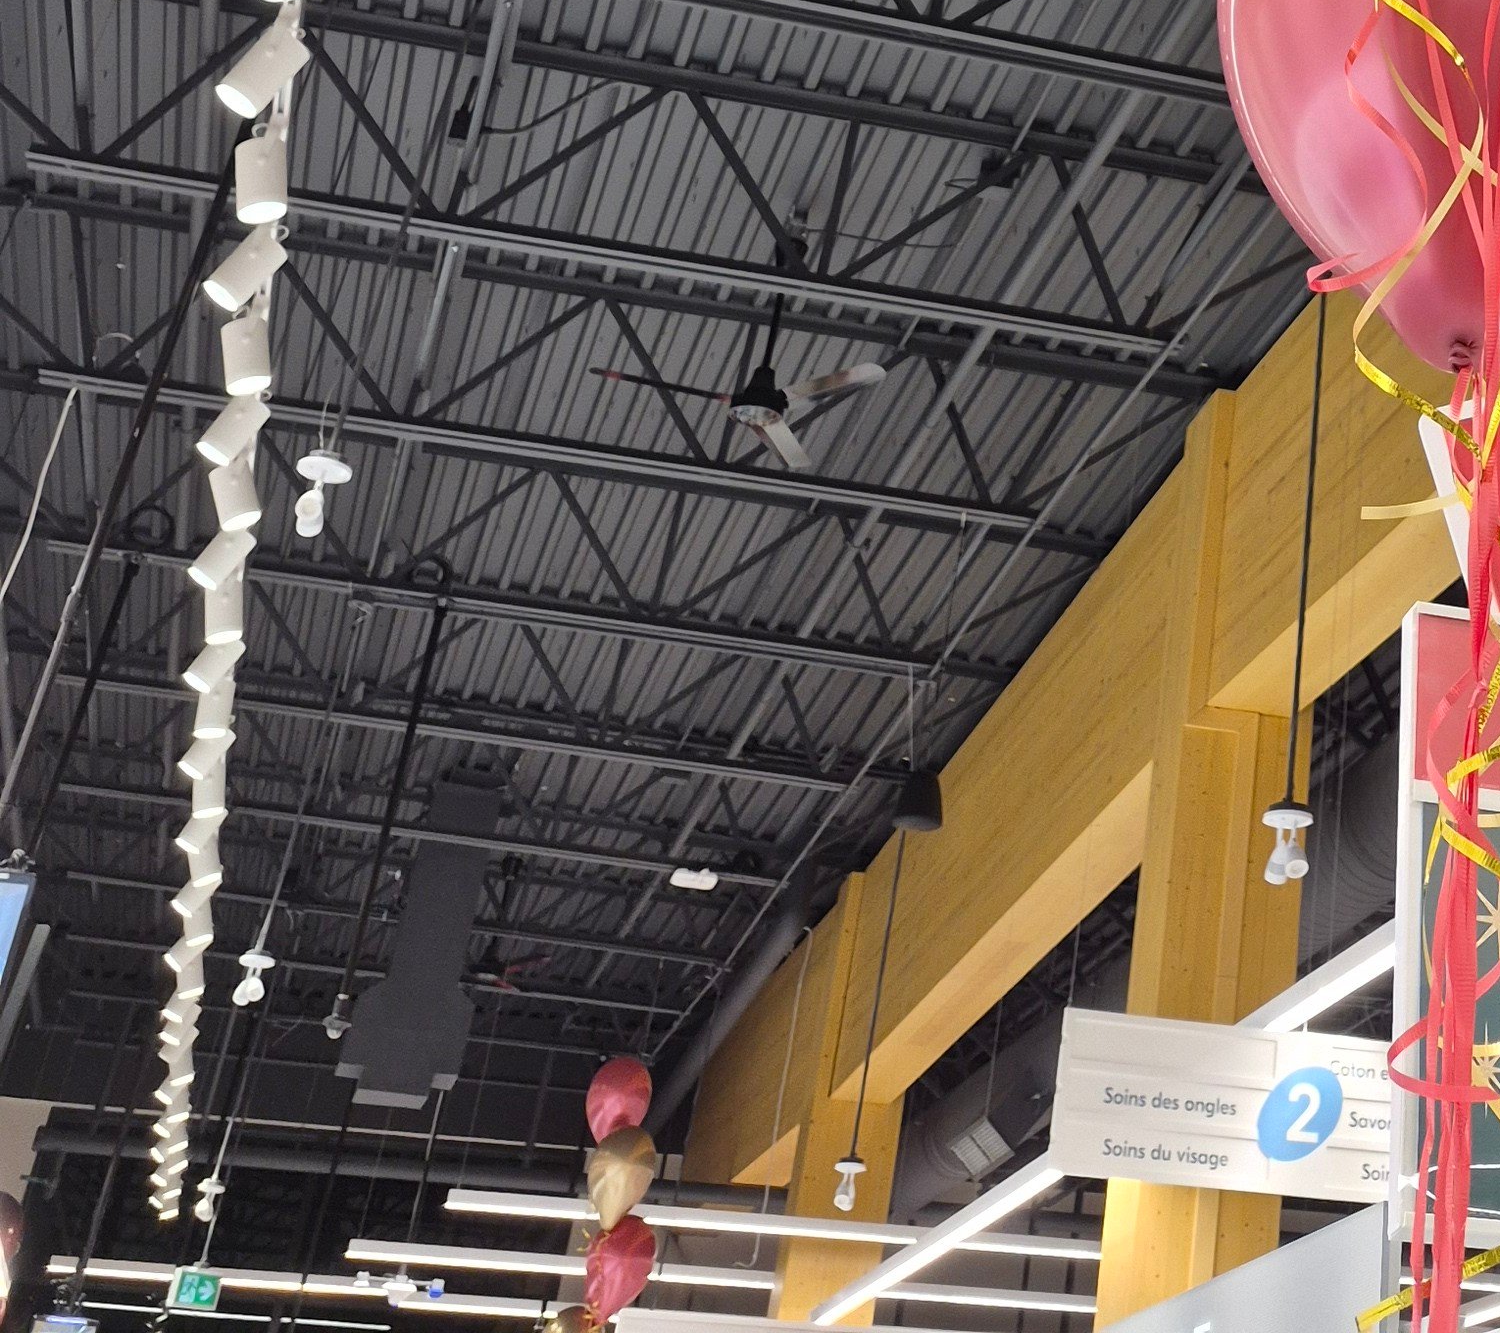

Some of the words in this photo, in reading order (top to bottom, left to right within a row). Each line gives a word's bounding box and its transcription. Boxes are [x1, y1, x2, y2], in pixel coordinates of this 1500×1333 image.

[1331, 1060, 1375, 1080] Coton
[1103, 1087, 1147, 1108] Soins
[1151, 1091, 1180, 1111] des
[1184, 1098, 1237, 1118] ongles
[1286, 1082, 1321, 1144] 2
[1102, 1138, 1146, 1160] Soins
[1150, 1143, 1172, 1162] du
[1176, 1146, 1229, 1171] visage
